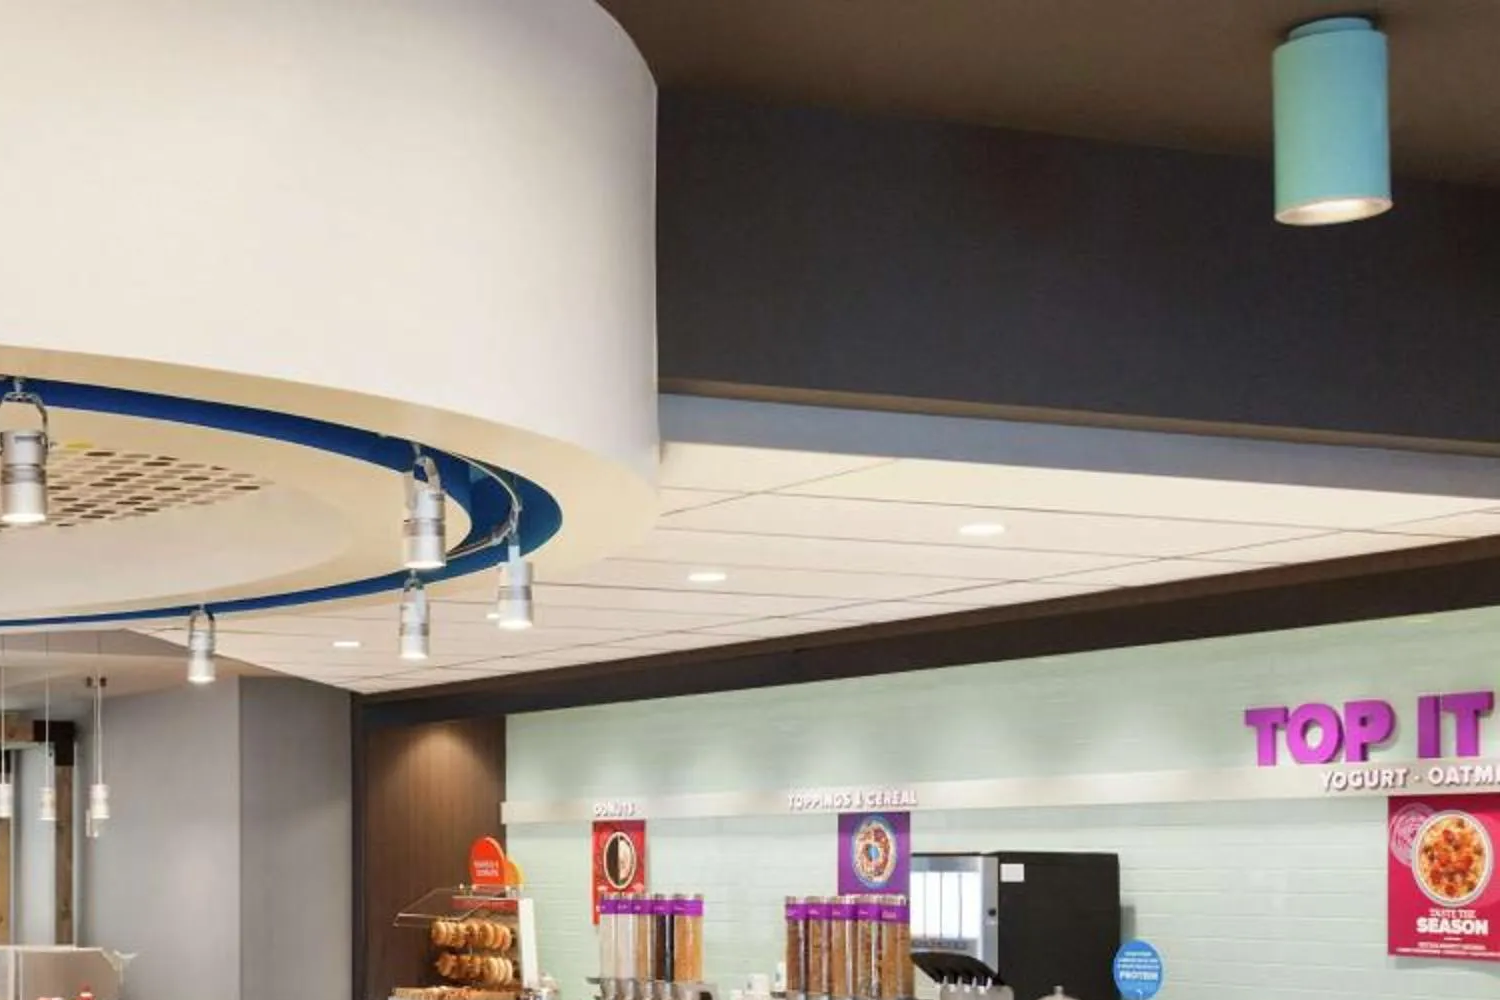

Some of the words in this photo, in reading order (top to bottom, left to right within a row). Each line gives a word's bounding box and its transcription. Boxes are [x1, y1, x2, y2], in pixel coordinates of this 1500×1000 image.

[1243, 699, 1396, 767] TOP
[1417, 690, 1495, 758] IT
[1319, 767, 1409, 791] YOGURT
[1428, 765, 1500, 787] OATM
[1415, 916, 1489, 936] SEASON
